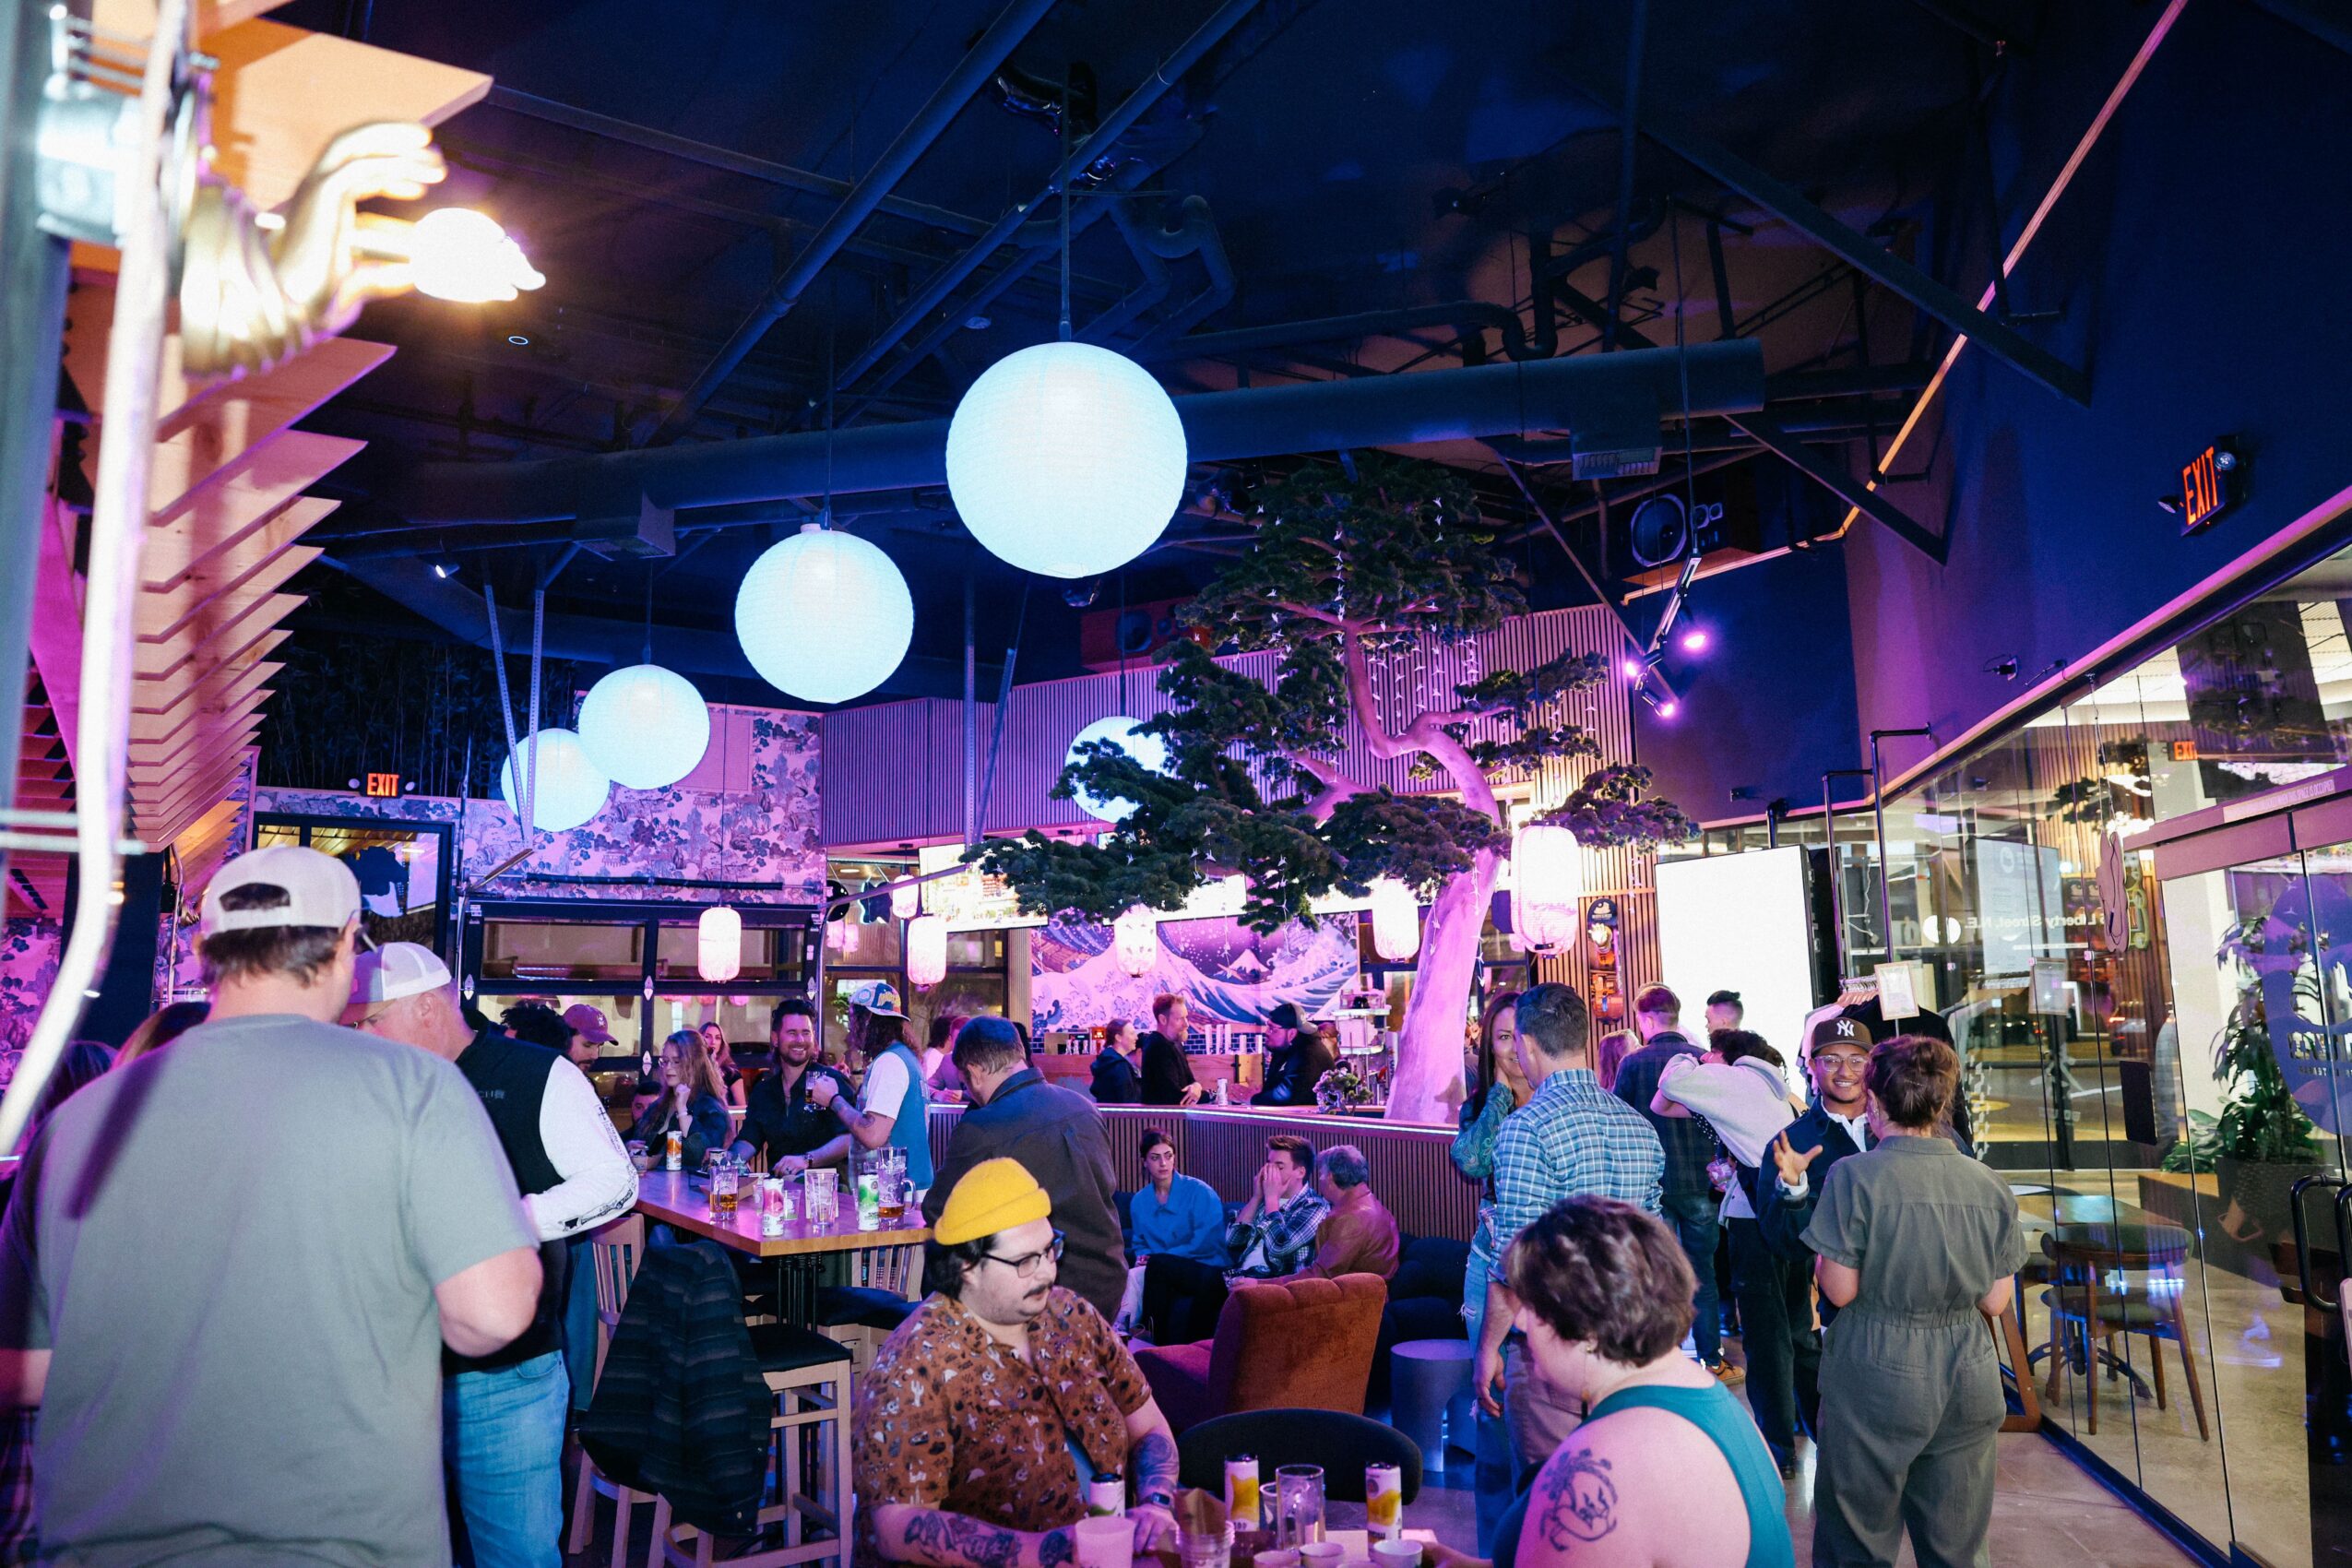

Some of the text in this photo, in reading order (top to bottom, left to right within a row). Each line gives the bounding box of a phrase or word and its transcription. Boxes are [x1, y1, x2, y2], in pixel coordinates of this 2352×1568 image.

[2182, 446, 2217, 526] EXIT
[366, 773, 399, 797] EXIT
[1836, 1019, 1855, 1037] NY
